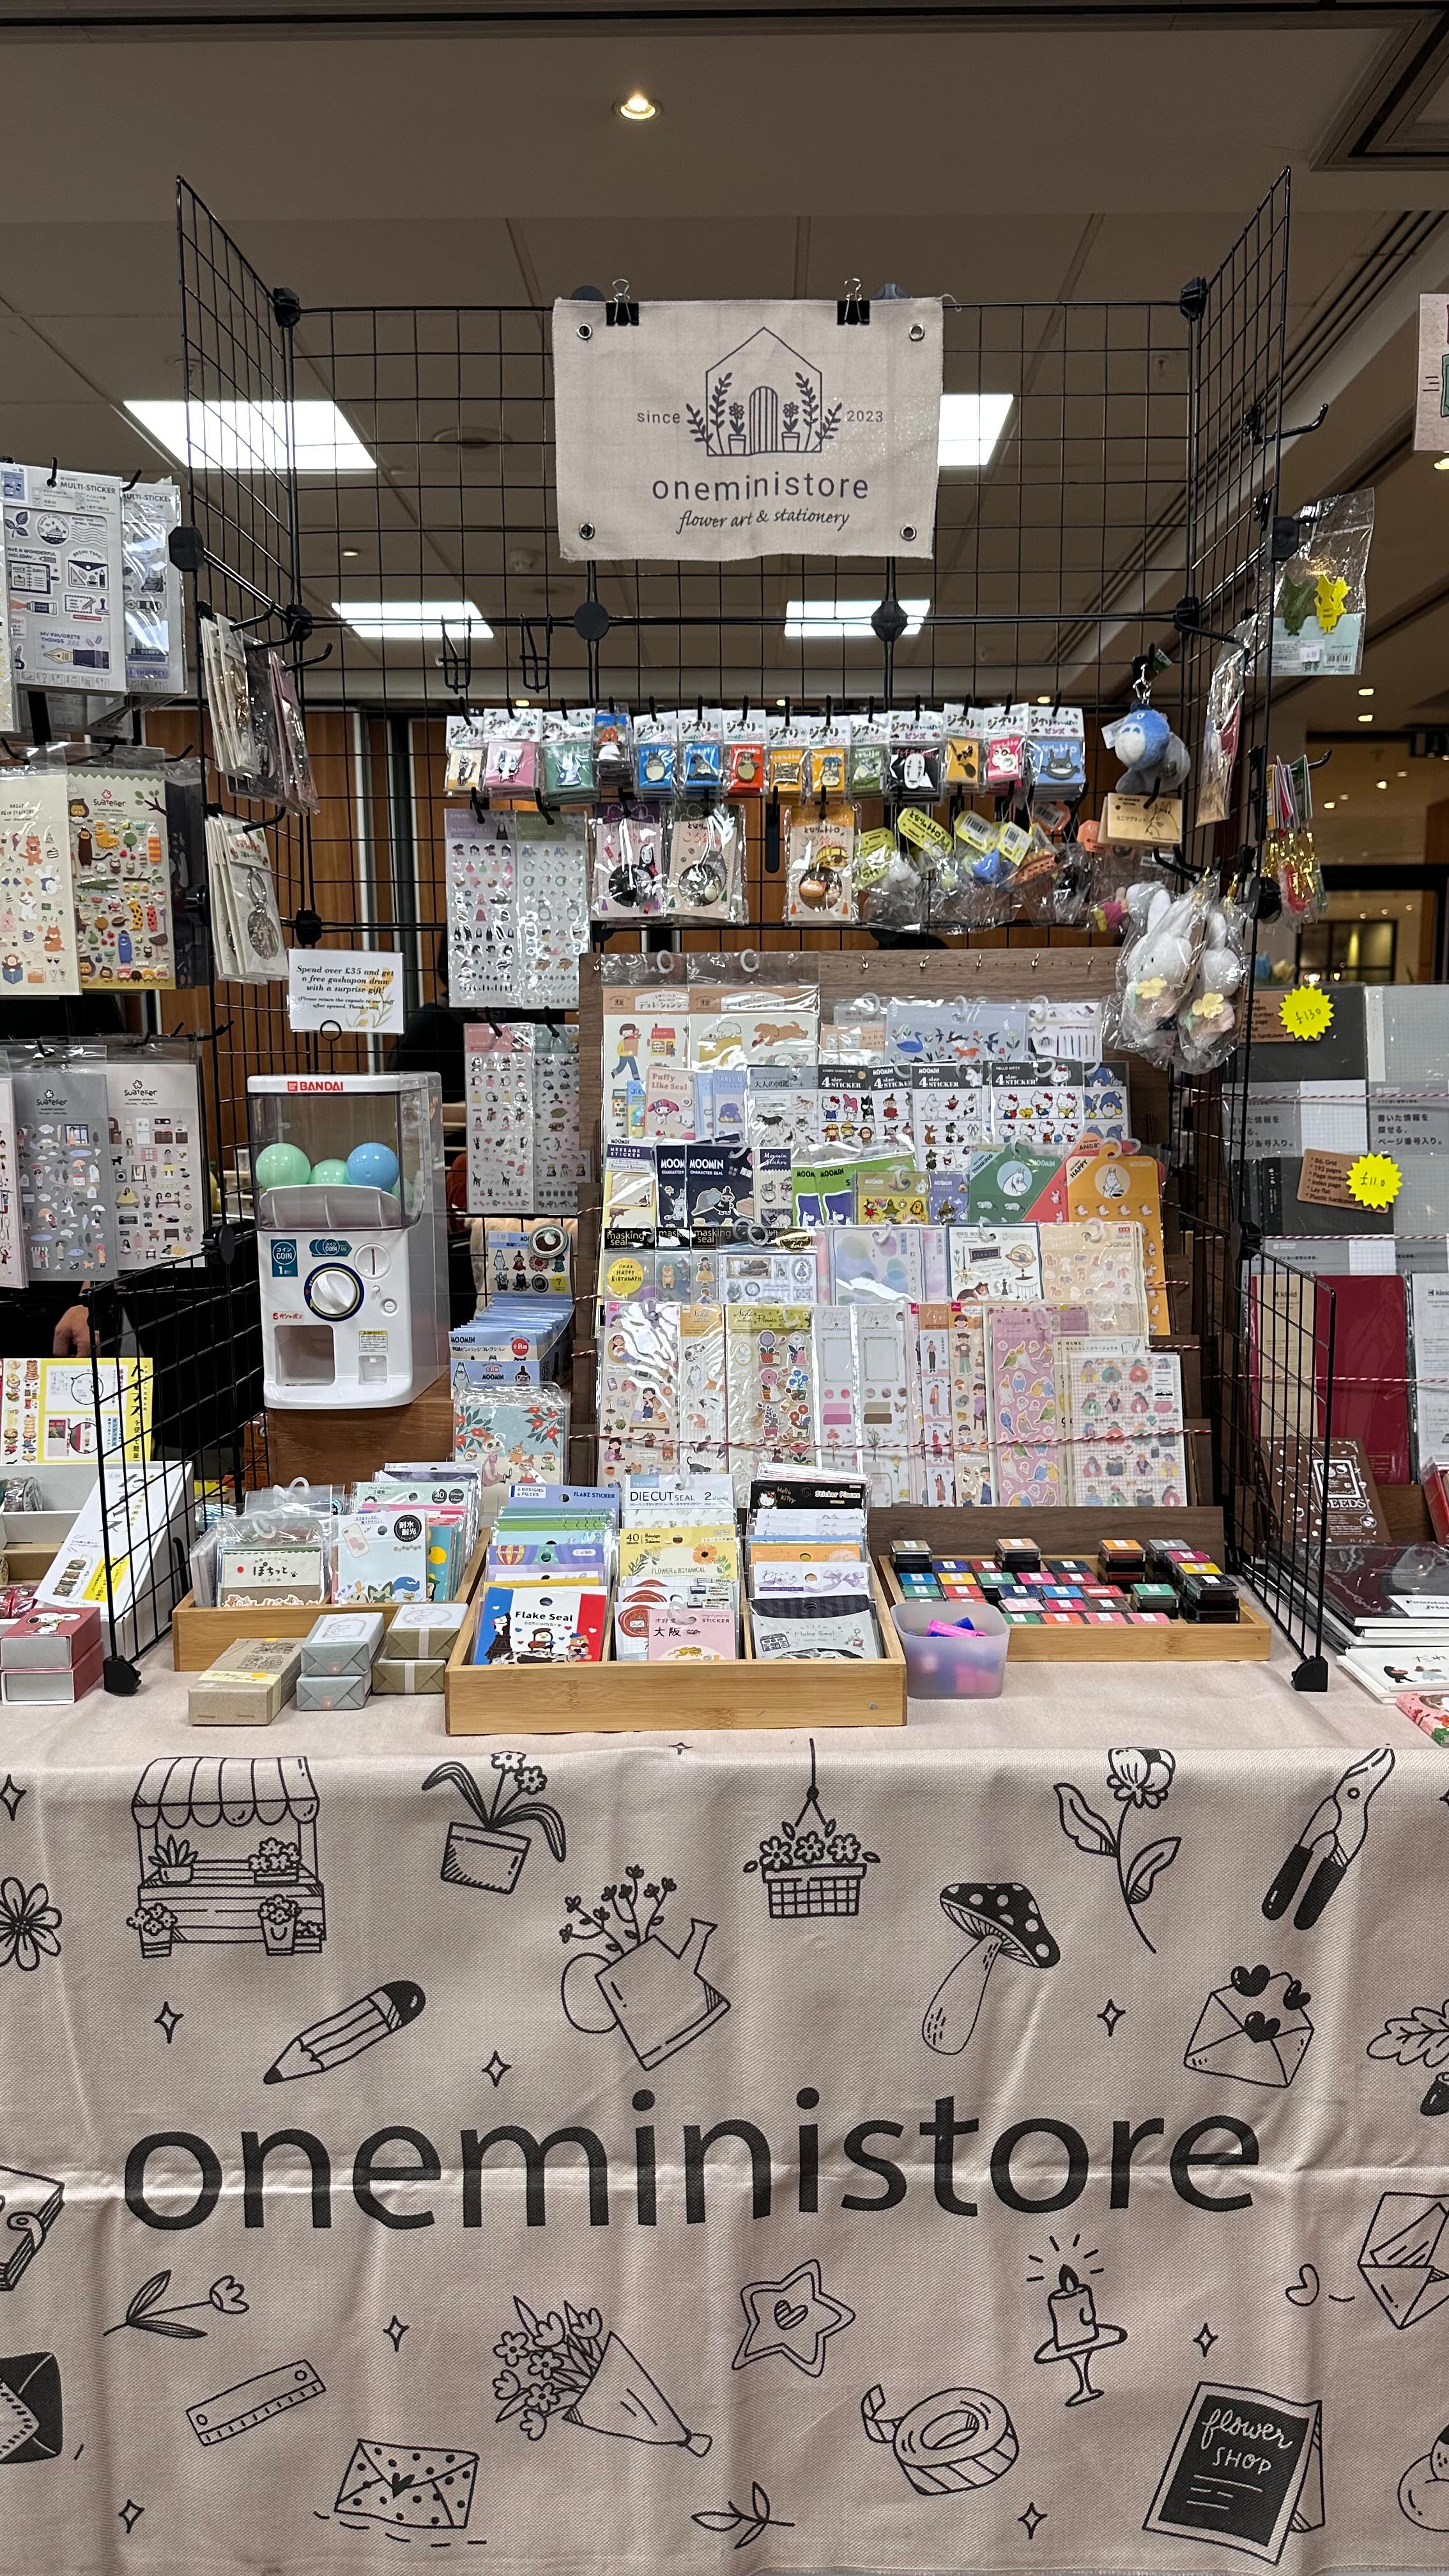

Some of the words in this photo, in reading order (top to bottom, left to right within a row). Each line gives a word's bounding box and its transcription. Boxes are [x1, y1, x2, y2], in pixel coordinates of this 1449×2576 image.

[637, 410, 680, 424] since
[847, 410, 883, 423] 2023
[61, 482, 116, 494] MULTI-STICKER
[652, 473, 868, 502] oneministore
[676, 510, 727, 534] flower
[730, 511, 752, 526] art
[756, 509, 769, 523] &
[774, 508, 850, 532] stationery
[296, 965, 322, 974] Spend
[308, 974, 325, 984] free
[328, 976, 367, 985] gashapon
[335, 986, 366, 994] surprise
[368, 986, 385, 995] gift!
[652, 1073, 675, 1082] Puffy
[822, 1077, 831, 1088] 4
[919, 1077, 927, 1087] 4
[995, 1075, 1004, 1085] 4
[300, 1081, 344, 1091] BANDAI
[874, 1078, 882, 1089] 4
[1377, 1114, 1429, 1123] 書いた情報を
[1377, 1126, 1407, 1135] 探せる。
[1378, 1137, 1442, 1147] ページ番号入り。
[661, 1158, 685, 1169] MOOM
[689, 1158, 724, 1170] MOOMIN
[971, 1153, 993, 1174] THINKING
[1070, 1159, 1089, 1178] HAPPY
[820, 1169, 844, 1177] MOOMIN
[607, 1230, 645, 1241] masking
[694, 1229, 731, 1239] masking
[698, 1232, 714, 1243] seal
[610, 1236, 627, 1245] seal
[777, 1485, 792, 1495] Hello
[815, 1490, 839, 1498] Sticker
[704, 1492, 712, 1501] 2
[401, 1528, 417, 1536] 耐光
[626, 1533, 640, 1542] 40
[253, 1562, 288, 1577] ぽちっと
[515, 1611, 546, 1620] Flake
[549, 1611, 573, 1621] Seal
[654, 1627, 682, 1637] 大阪
[125, 2086, 1260, 2232] oneministore
[1201, 2408, 1293, 2450] flower
[1212, 2446, 1271, 2474] SHOP
